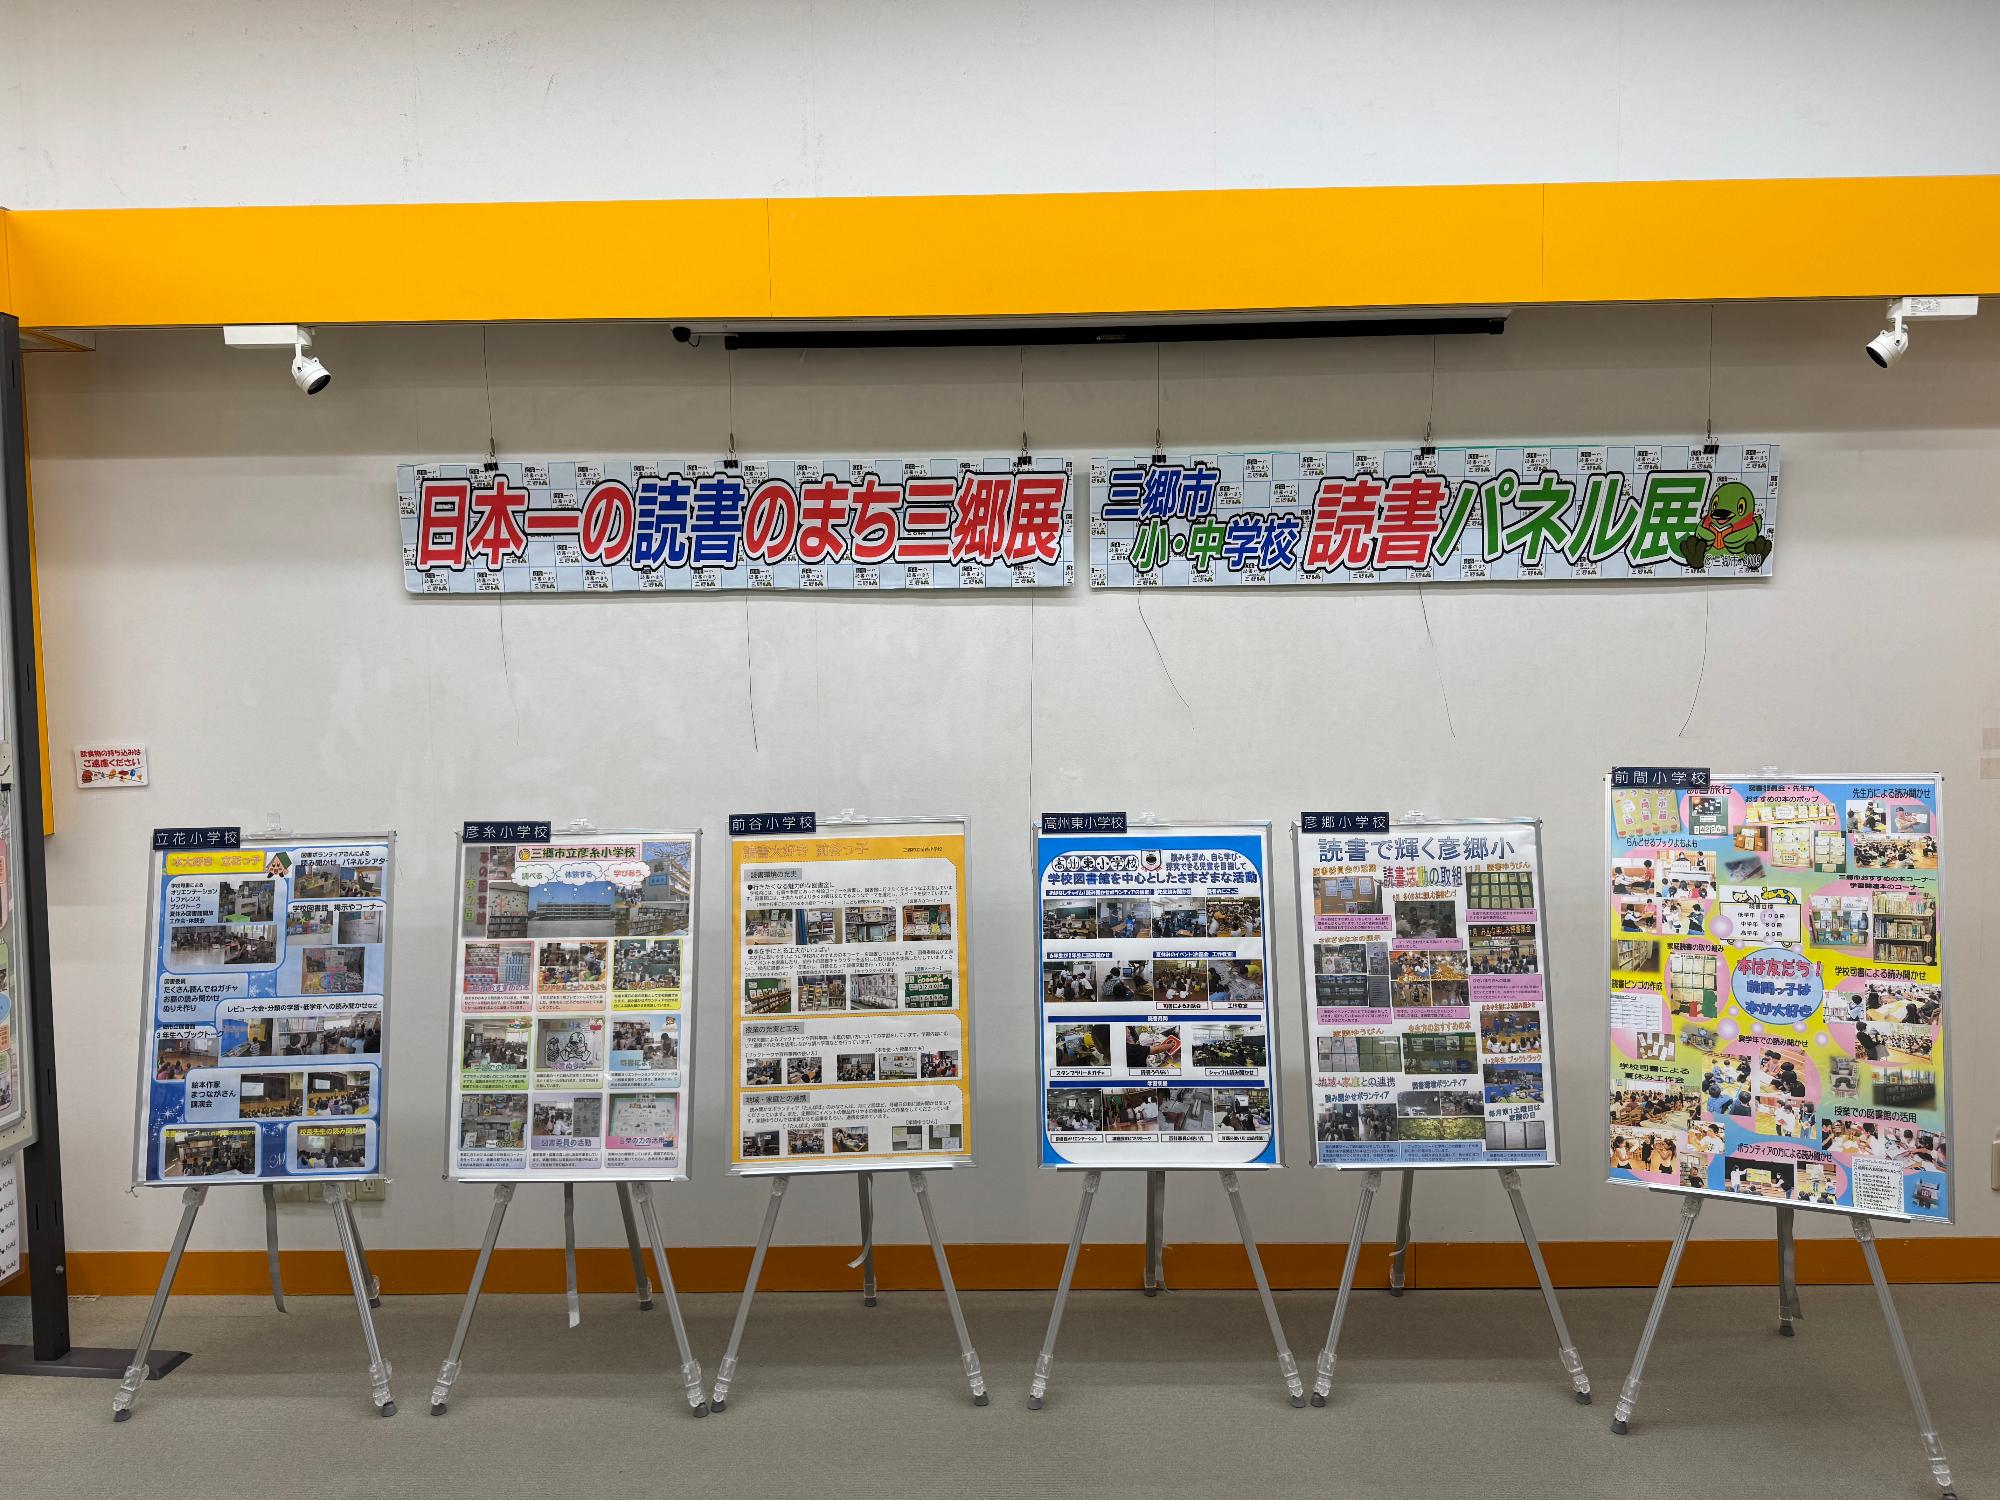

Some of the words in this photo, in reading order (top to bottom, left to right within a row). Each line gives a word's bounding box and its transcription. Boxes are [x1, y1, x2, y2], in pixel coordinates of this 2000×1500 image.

[1103, 467, 1218, 518] 三郷市
[418, 475, 1066, 569] 日本一の読書のまち三郷展
[1307, 475, 1707, 566] 読書パネル展
[1130, 515, 1300, 570] 小・中学校
[83, 758, 141, 768] ご遠慮ください
[1615, 770, 1708, 785] 前間小学校
[1852, 787, 1931, 799] 先生方による読み聞かせ
[732, 815, 815, 831] 前谷小学校
[1044, 815, 1125, 831] 高州東小学校
[1304, 815, 1387, 830] 彦郷小学校
[155, 831, 239, 846] 立花小学校
[465, 825, 549, 839] 彦糸小学校
[1318, 836, 1515, 862] 読書で輝く彦郷小
[1626, 838, 1698, 849] らんどせるブックよもよも
[531, 847, 636, 859] 三郷市立彦糸小学校
[1052, 856, 1139, 872] 高州東小学校
[1048, 871, 1257, 886] 学校図書館を中心としたさまざまな活動
[1834, 966, 1927, 981] 学校司書による読み聞かせ
[1745, 1000, 1813, 1017] 本が大好き
[1834, 1106, 1917, 1123] 授業での図書館の活用
[1737, 1142, 1833, 1161] ボランティアの方による読み聞かせ
